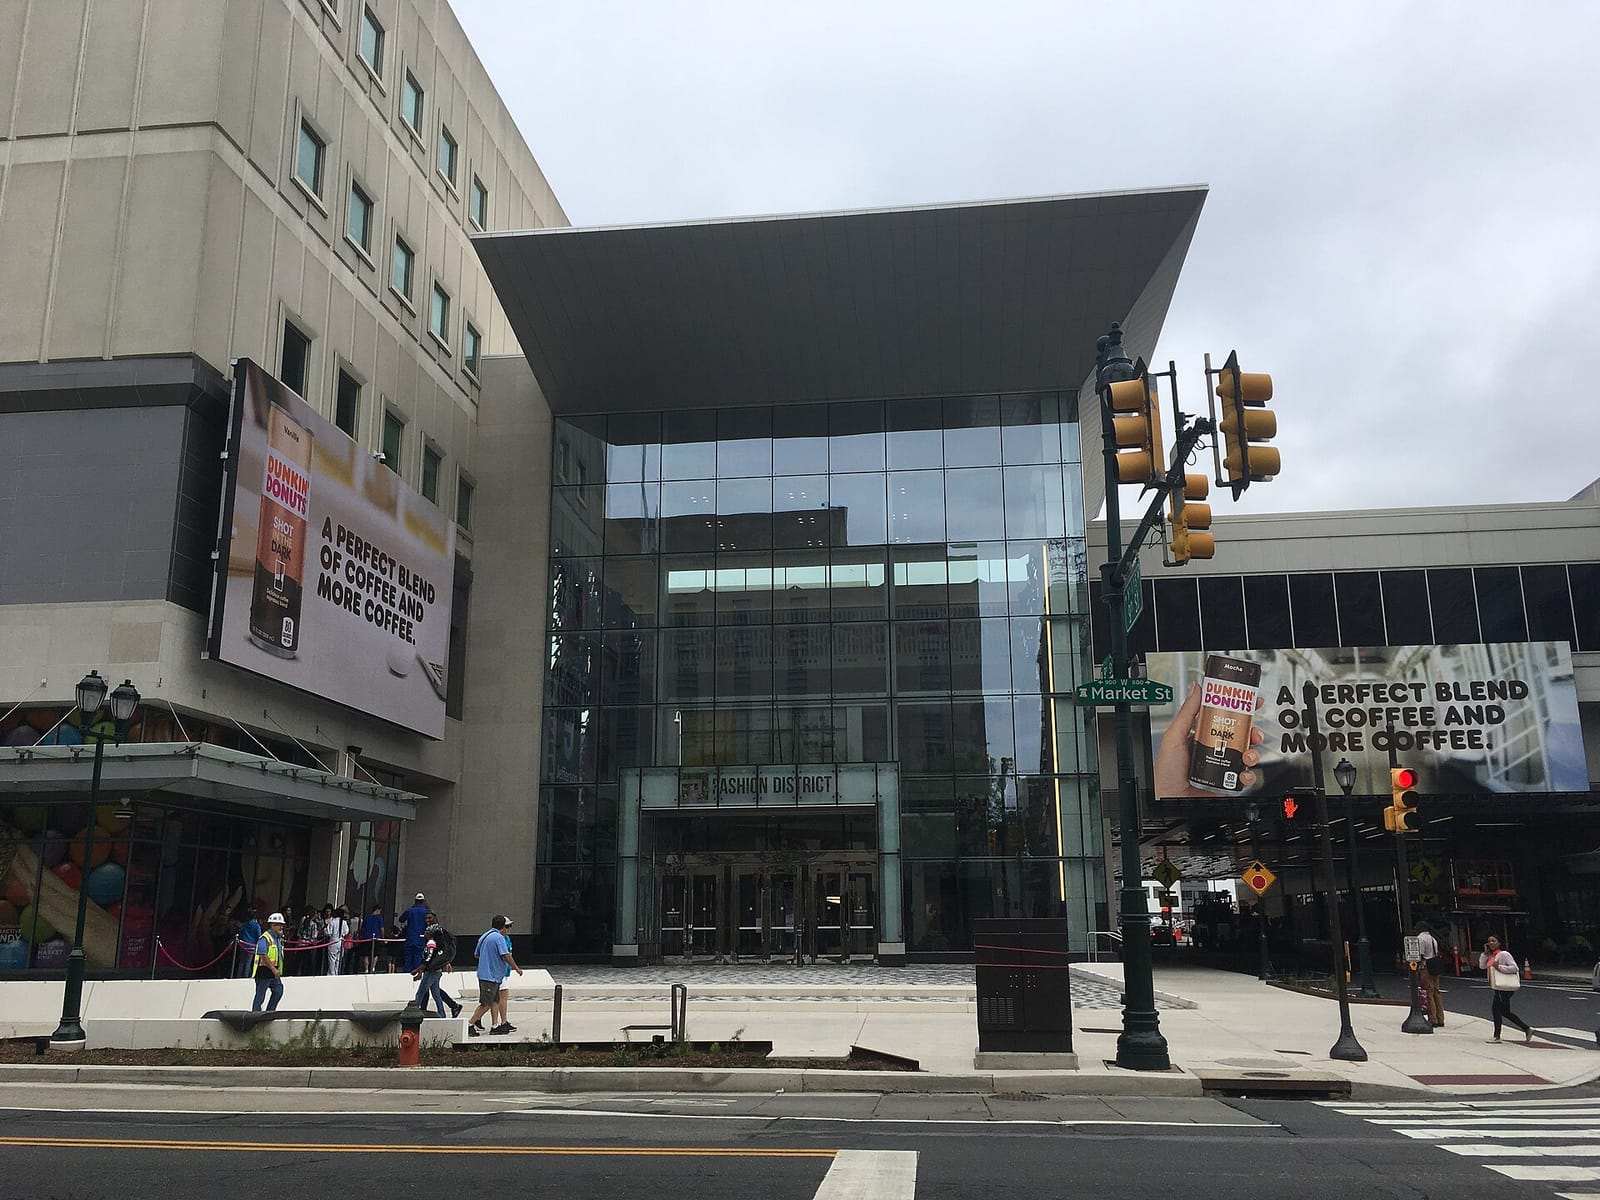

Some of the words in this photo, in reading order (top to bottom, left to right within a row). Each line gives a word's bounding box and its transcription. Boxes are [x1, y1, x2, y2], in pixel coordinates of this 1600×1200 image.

[268, 454, 309, 497] DUNKIN'
[266, 473, 307, 515] DONUTS
[273, 516, 294, 536] SHOT
[271, 540, 292, 561] DARK
[321, 516, 333, 543] A
[336, 524, 397, 581] PERFECT
[398, 564, 436, 605] BLEND
[320, 545, 342, 575] OF
[345, 559, 397, 609] COFFEE
[398, 591, 424, 623] AND
[317, 572, 362, 617] MORE
[364, 598, 416, 646] COFFEE.
[1224, 664, 1243, 672] Mocha
[1091, 687, 1148, 700] Market
[1155, 688, 1171, 700] St
[1206, 682, 1256, 701] DUNKIN'
[1276, 685, 1296, 705] A
[1434, 680, 1529, 702] BLEND
[1204, 693, 1252, 712] DONUTS
[1213, 716, 1237, 726] SHOT
[1325, 706, 1436, 728] COFFEE
[1444, 705, 1506, 726] AND
[1210, 728, 1235, 740] DARK
[1280, 731, 1365, 753] MORE
[1371, 729, 1494, 752] COFFEE.
[773, 776, 832, 793] DISTRICT
[0, 934, 22, 942] NDY
